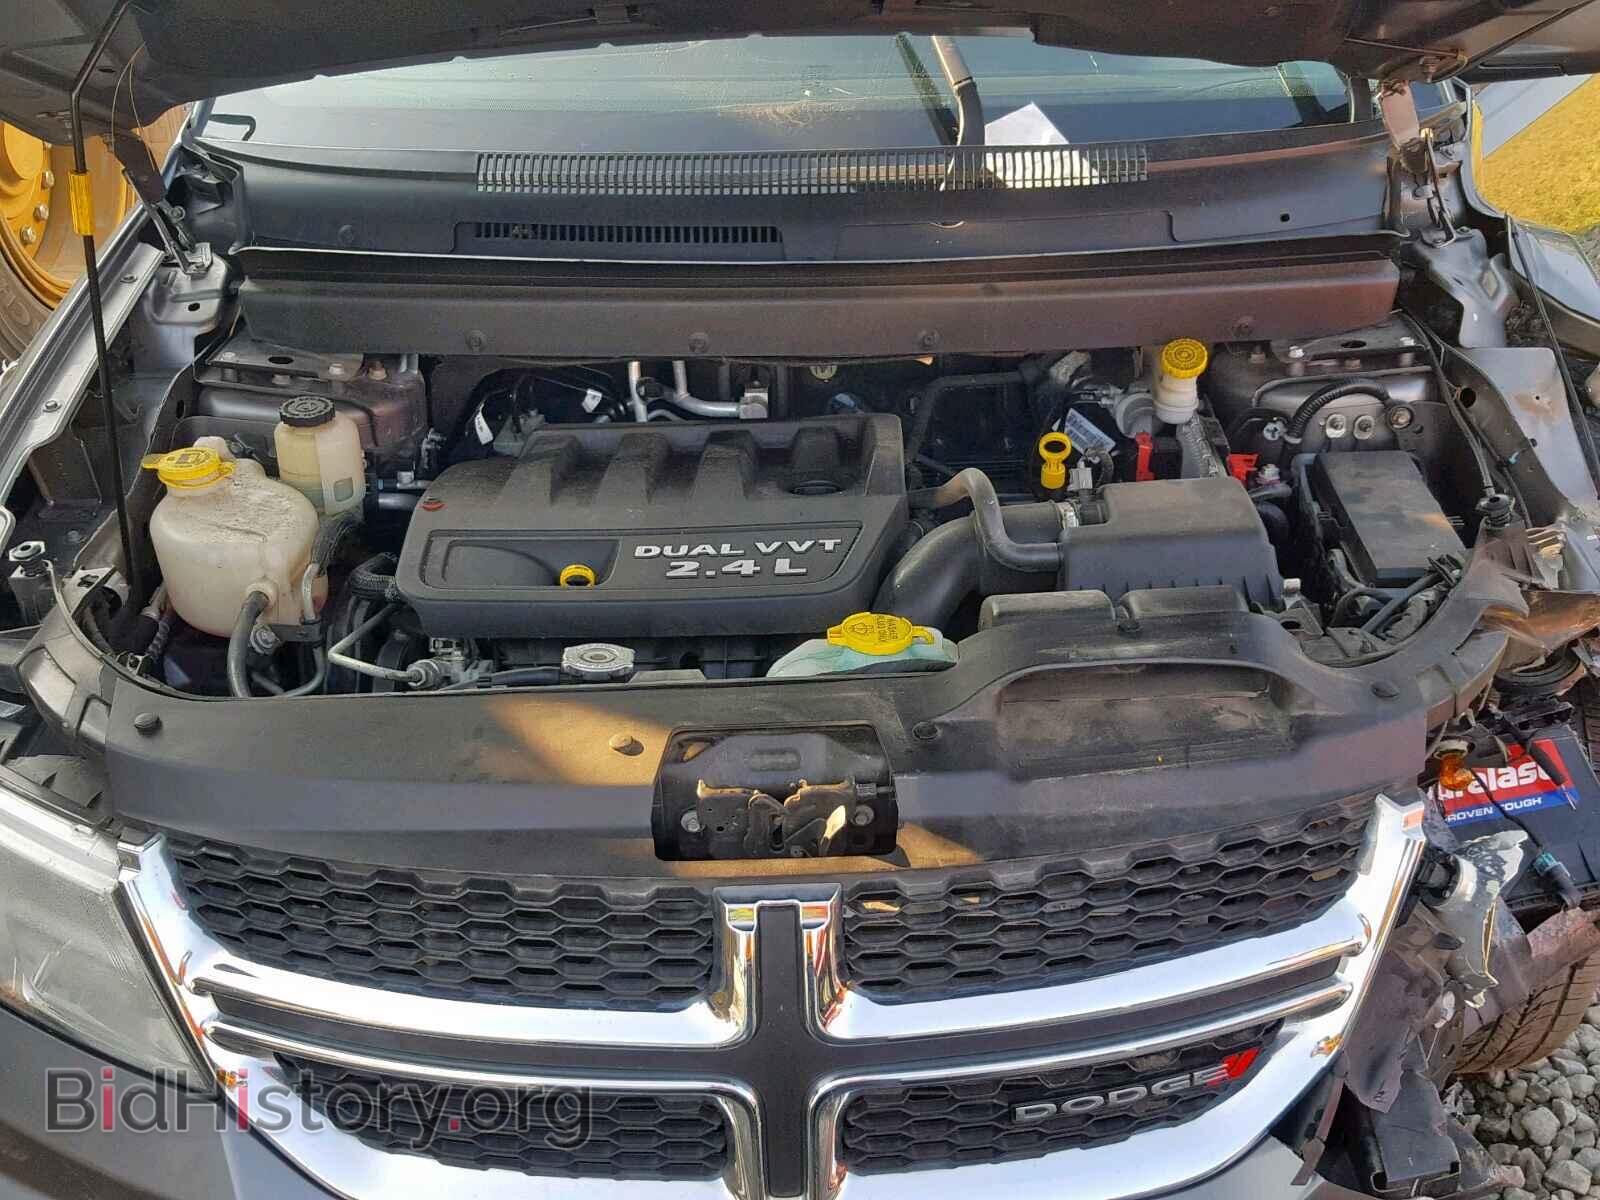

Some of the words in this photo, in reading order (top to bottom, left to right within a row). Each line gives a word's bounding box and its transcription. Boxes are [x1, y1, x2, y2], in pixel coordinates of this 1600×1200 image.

[634, 543, 745, 558] DUAL
[755, 539, 842, 554] VVT
[665, 559, 761, 578] 2.4
[774, 558, 807, 576] L
[1428, 761, 1551, 800] ualas
[1446, 807, 1493, 822] ROVEN
[1014, 1063, 1230, 1123] DODGE
